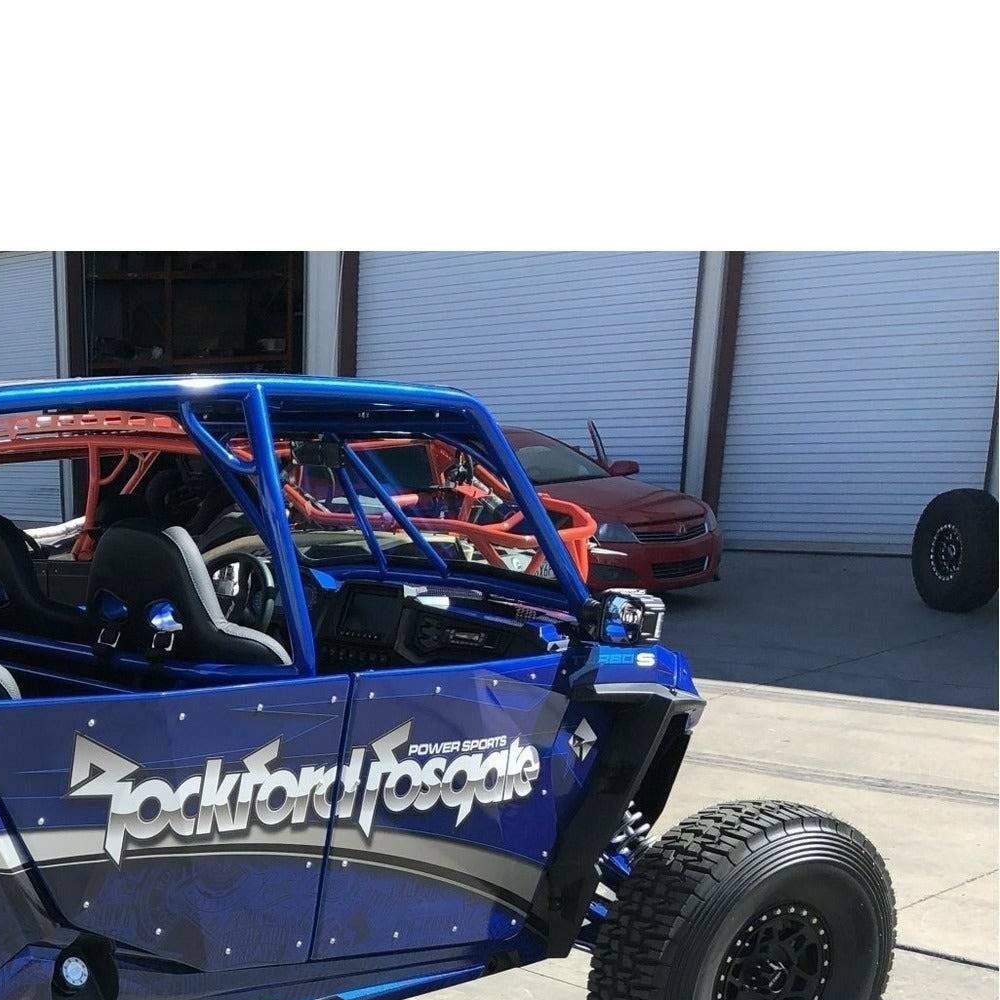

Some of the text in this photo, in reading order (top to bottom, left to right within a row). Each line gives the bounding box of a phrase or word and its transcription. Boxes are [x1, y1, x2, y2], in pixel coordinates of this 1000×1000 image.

[636, 652, 656, 667] S
[408, 735, 507, 757] POWER SPORTS
[68, 718, 541, 869] Rockford Fosgate
